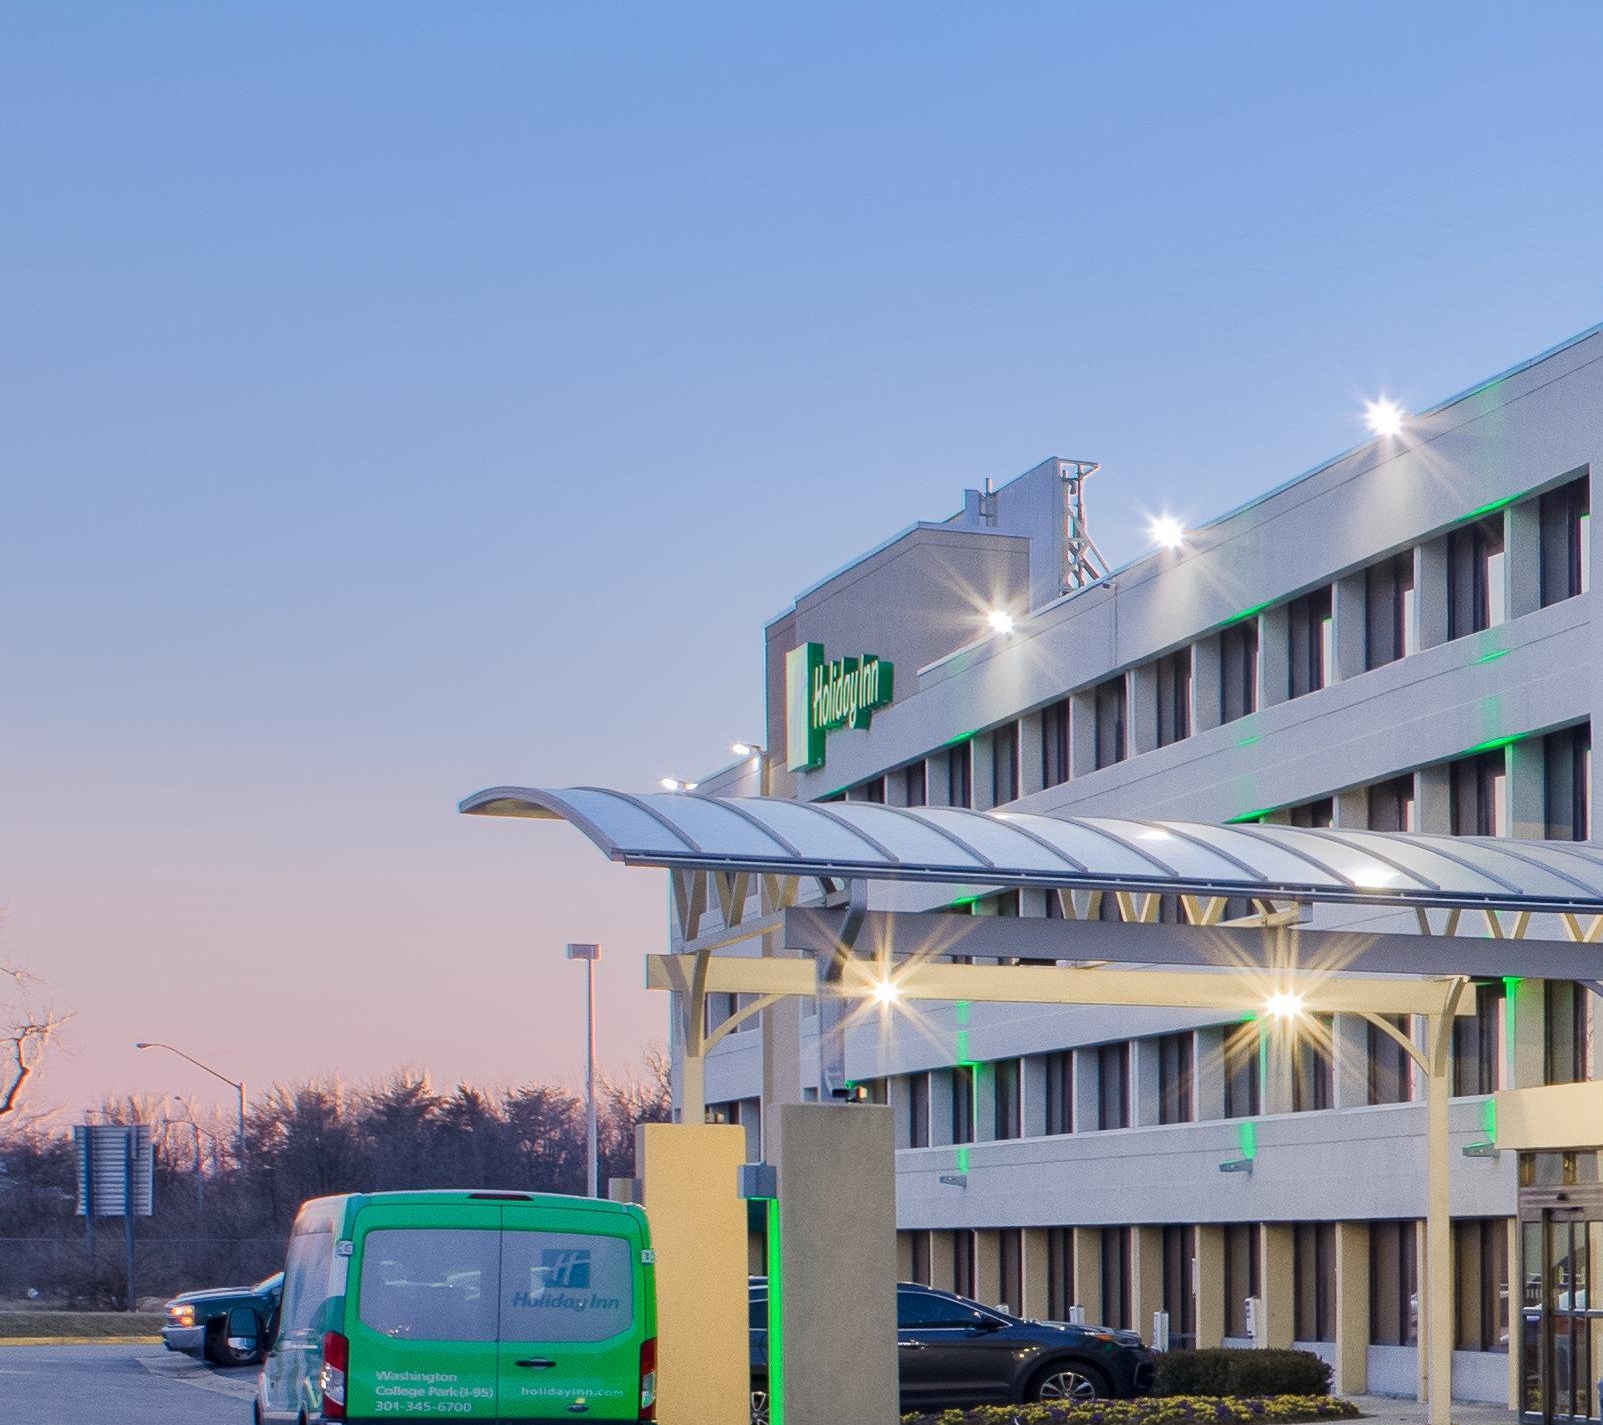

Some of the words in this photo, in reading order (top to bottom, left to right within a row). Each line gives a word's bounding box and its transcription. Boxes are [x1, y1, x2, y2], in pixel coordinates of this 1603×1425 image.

[813, 657, 859, 729] Holiday
[859, 654, 879, 709] Inn
[512, 1292, 586, 1311] Holiday
[590, 1294, 620, 1308] Inn
[376, 1371, 457, 1384] Washington
[376, 1386, 426, 1398] College
[428, 1387, 458, 1397] Park
[521, 1387, 624, 1398] holidayinn.com
[376, 1401, 472, 1413] 301-345-6700
